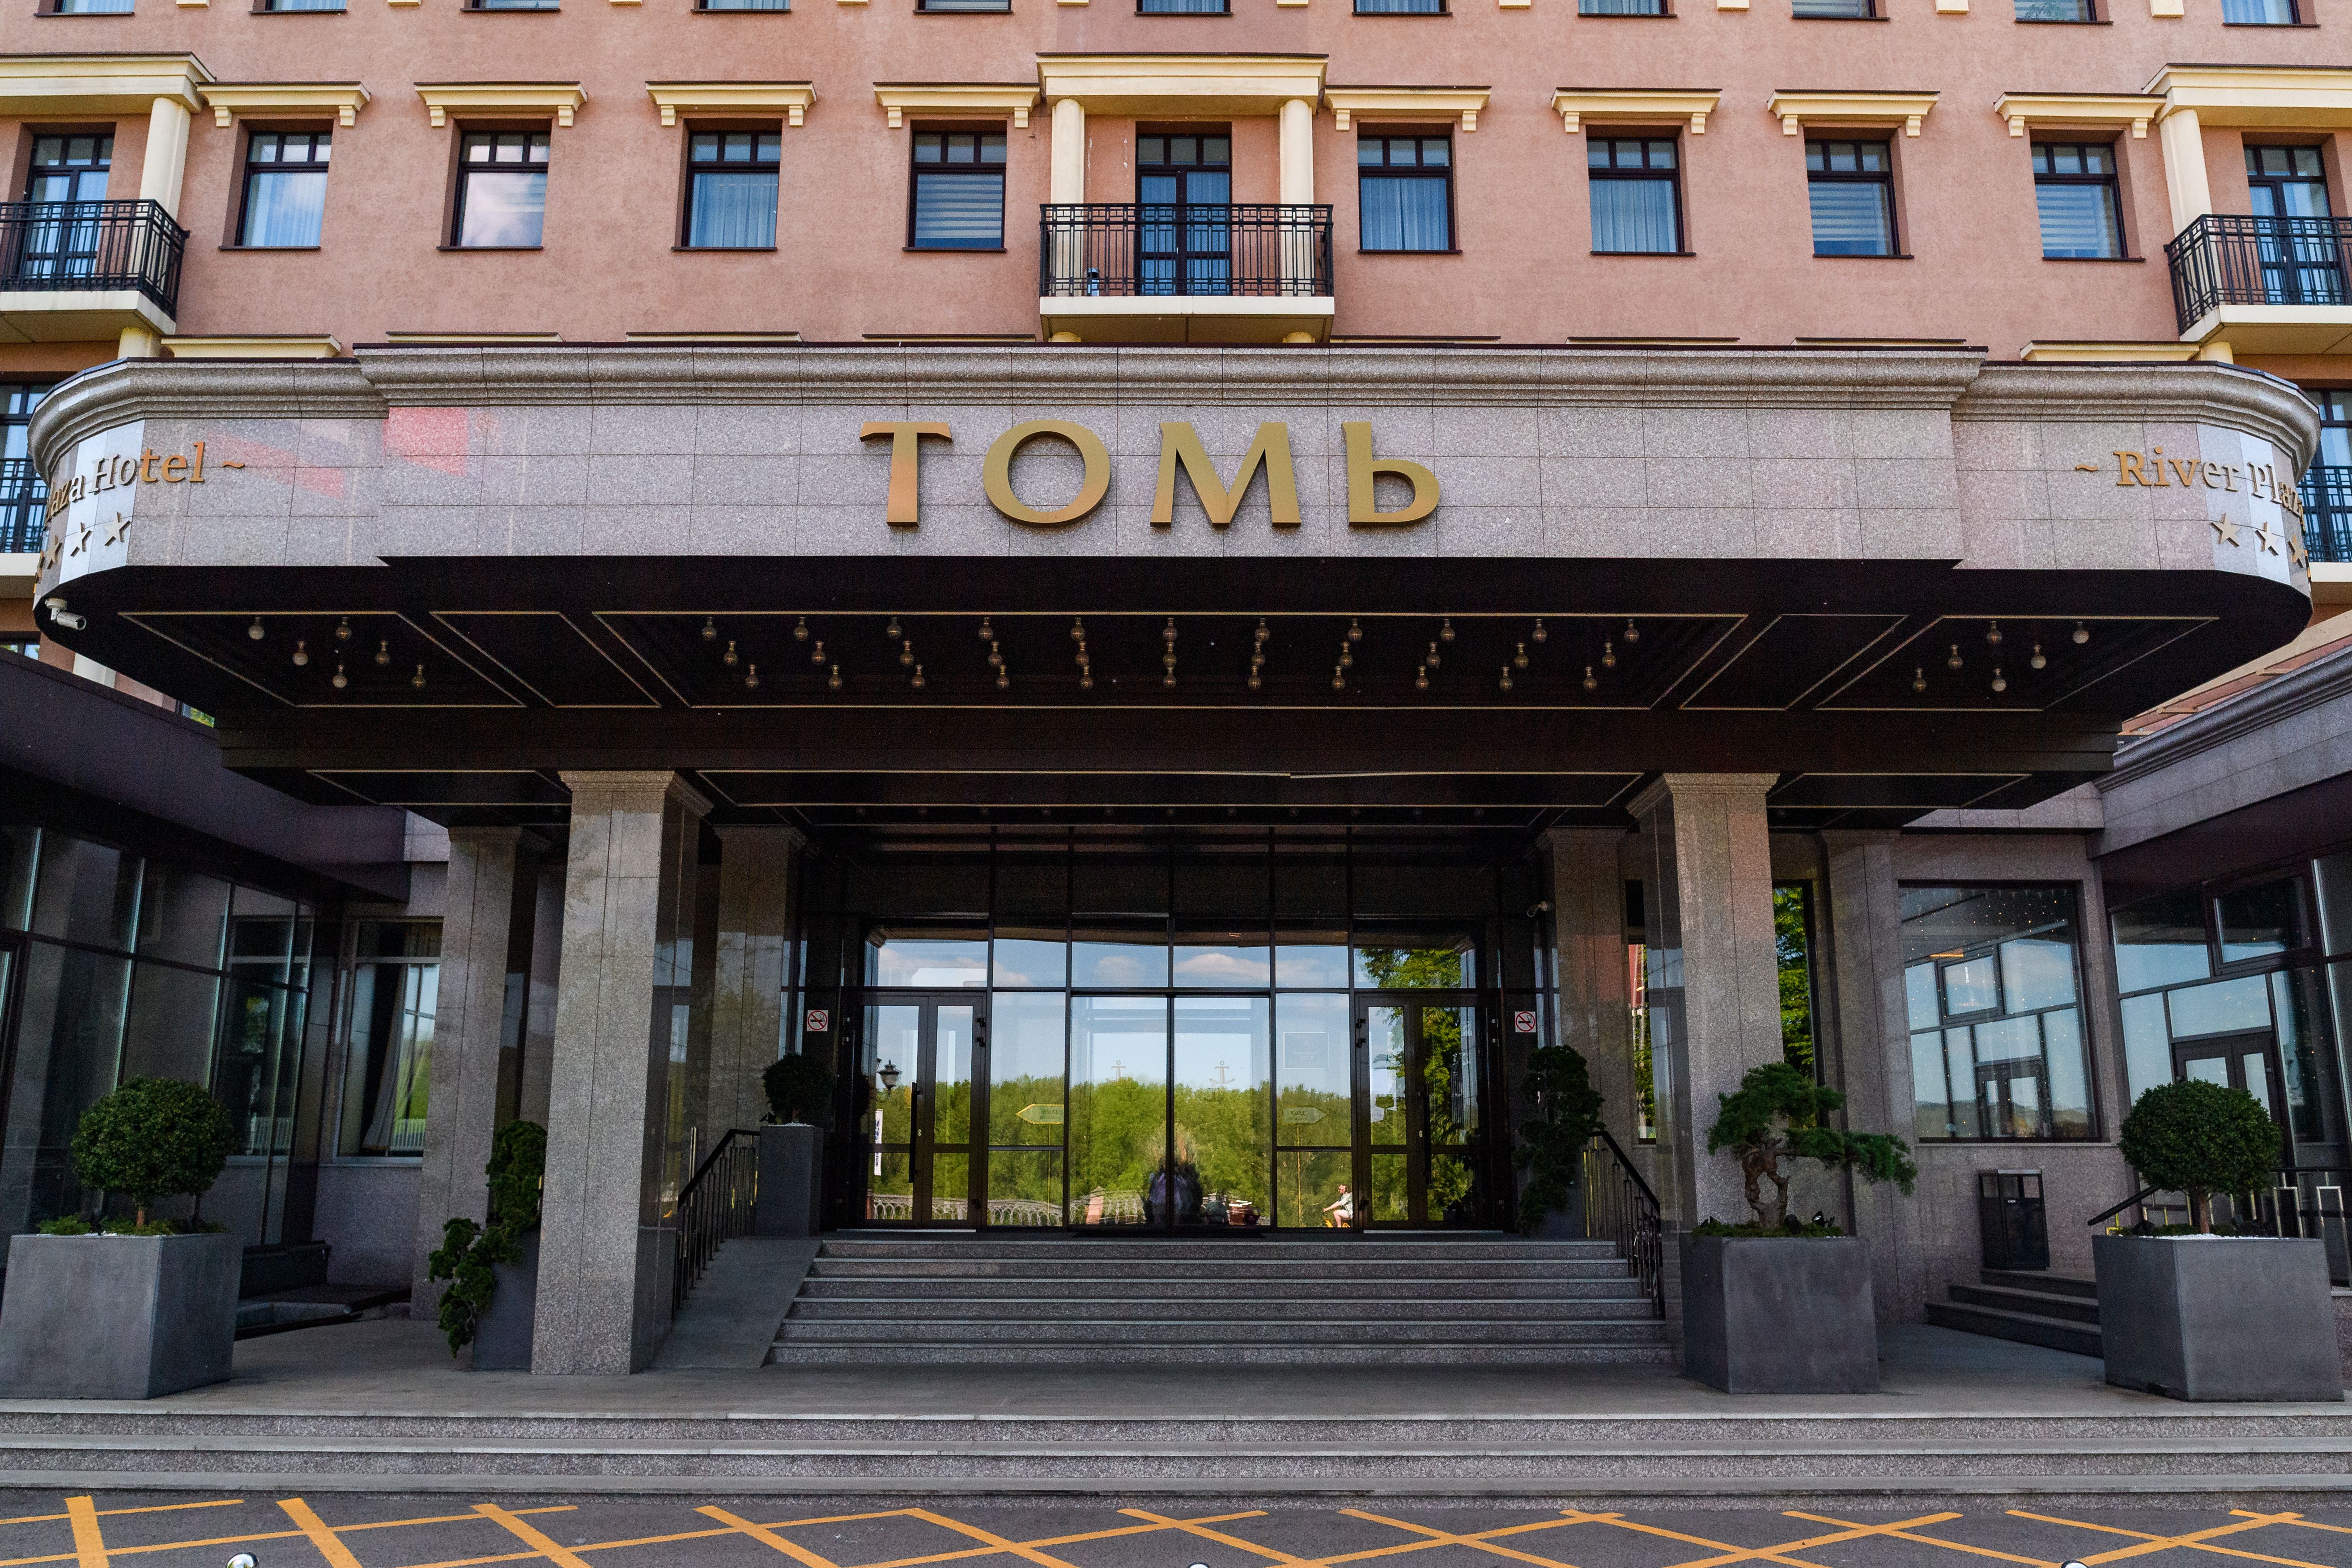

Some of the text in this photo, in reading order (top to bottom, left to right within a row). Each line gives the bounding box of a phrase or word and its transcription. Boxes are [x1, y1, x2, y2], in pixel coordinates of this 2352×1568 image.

[88, 441, 205, 495] Hotel
[859, 419, 1441, 528] ТОМЬ
[2113, 446, 2306, 531] River Plaz
